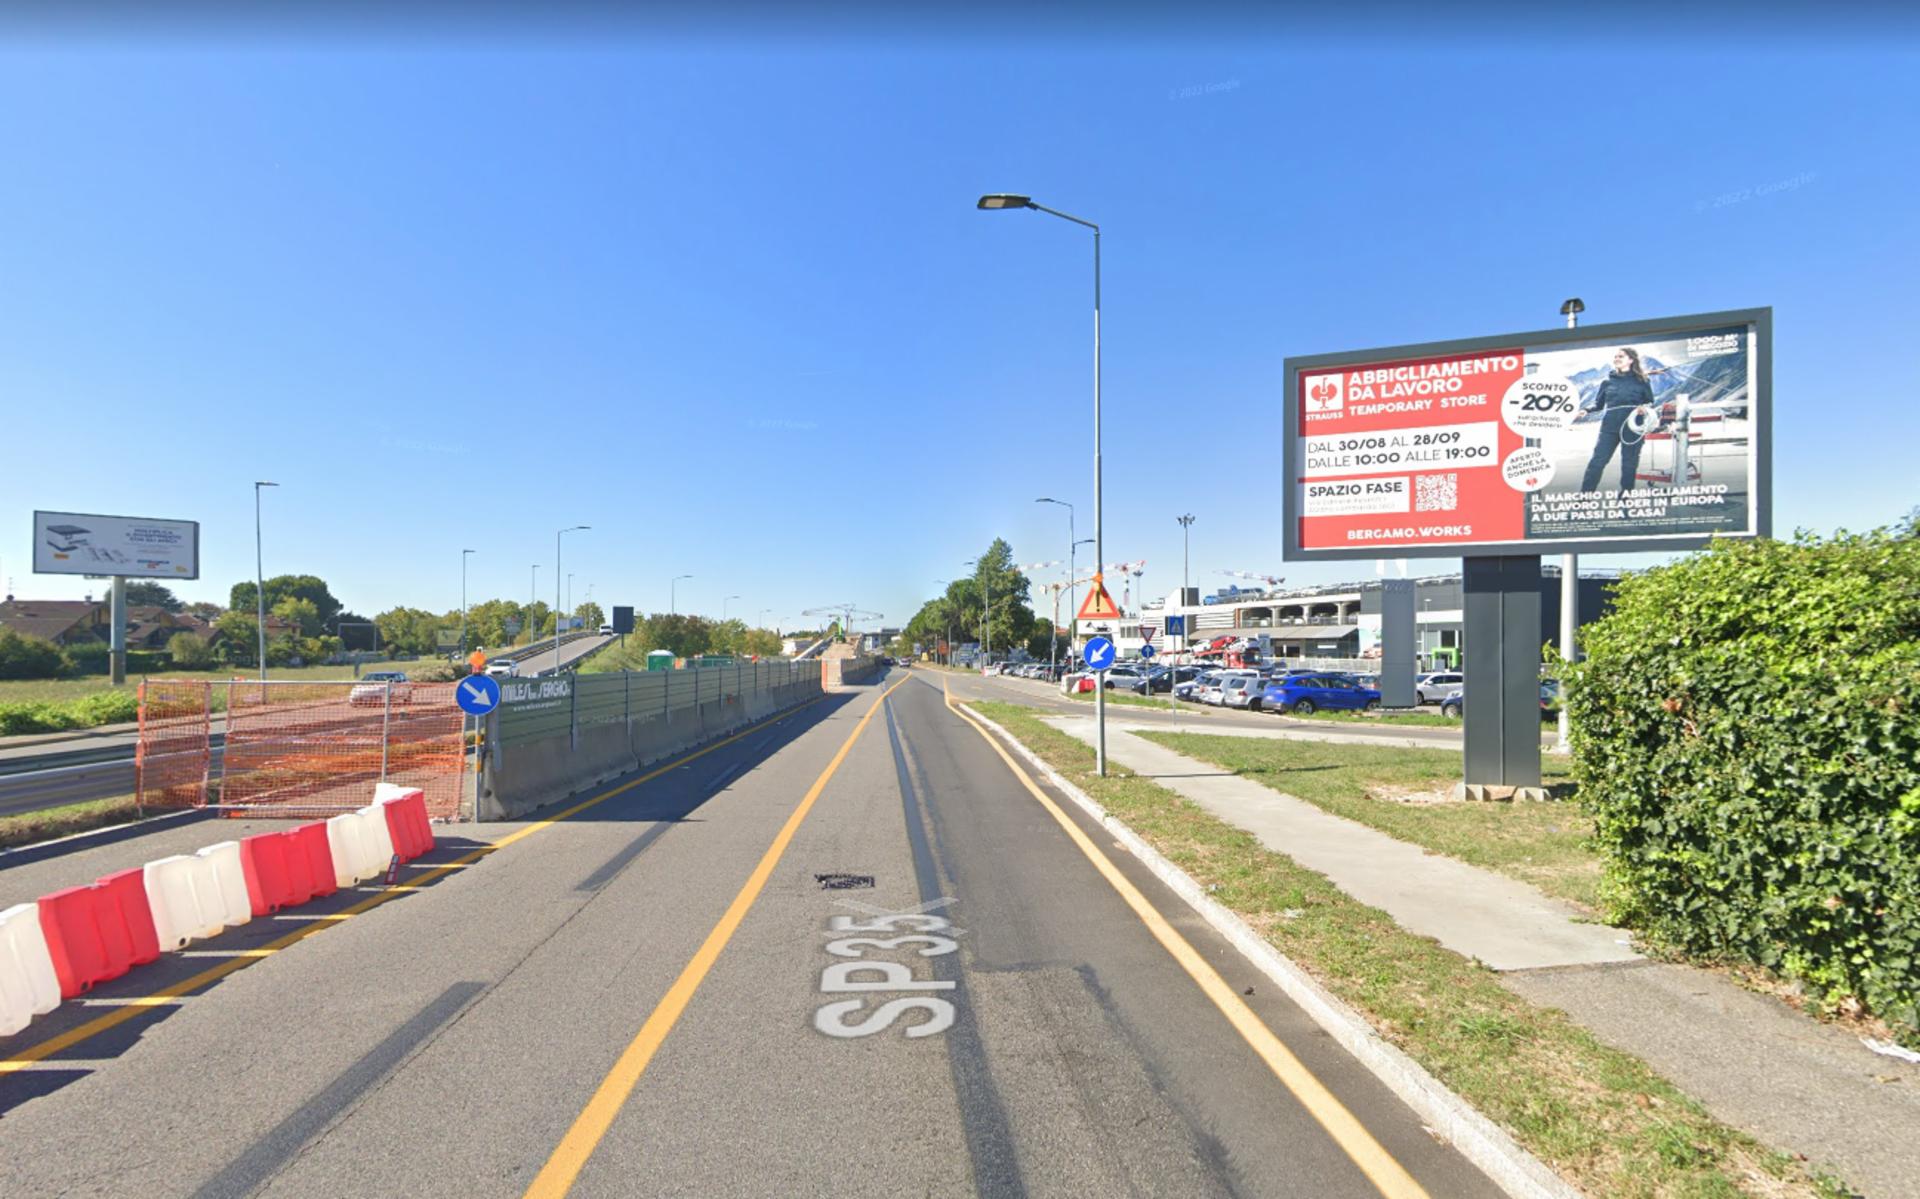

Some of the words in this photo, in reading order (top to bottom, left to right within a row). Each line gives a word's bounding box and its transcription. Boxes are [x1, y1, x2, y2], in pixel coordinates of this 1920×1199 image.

[1349, 356, 1518, 386] ABBIGLIAMENTO
[1349, 385, 1375, 401] DA
[1381, 377, 1462, 399] LAVORO
[1522, 382, 1568, 392] SCONTO
[1348, 399, 1433, 416] TEMPORARY
[1440, 394, 1487, 408] STORE
[1509, 393, 1574, 413] -20%
[1305, 412, 1343, 422] STRAUSS
[1308, 441, 1335, 454] DAL
[1338, 437, 1386, 451] 30/08
[1390, 436, 1409, 447] AL
[1413, 432, 1461, 445] 28/09
[1308, 455, 1351, 469] DALLE
[1355, 452, 1400, 465] 10:00
[1404, 450, 1441, 462] ALLE
[1445, 446, 1490, 460] 19:00
[1507, 460, 1533, 472] ANCHE
[1510, 451, 1541, 463] APERTO
[1508, 464, 1551, 479] DOMENICA
[1309, 484, 1362, 497] SPAZIO
[1366, 482, 1403, 494] FASE
[1531, 494, 1543, 503] IL
[1545, 491, 1602, 503] MARCHIO
[1605, 490, 1619, 500] DI
[1621, 484, 1729, 499] ABBIGLIAMENTO
[1531, 503, 1548, 513] DA
[1551, 501, 1599, 512] LAVORO
[1602, 498, 1651, 510] LEADER
[1653, 497, 1668, 507] IN
[1671, 494, 1724, 506] EUROPA
[1531, 512, 1541, 522] A
[1543, 511, 1568, 522] DUE
[1570, 509, 1605, 521] PASSI
[1607, 509, 1625, 519] DA
[1628, 507, 1666, 518] CASA!
[1347, 525, 1472, 540] BERGAMO.WORKS
[814, 913, 958, 1038] SP35
